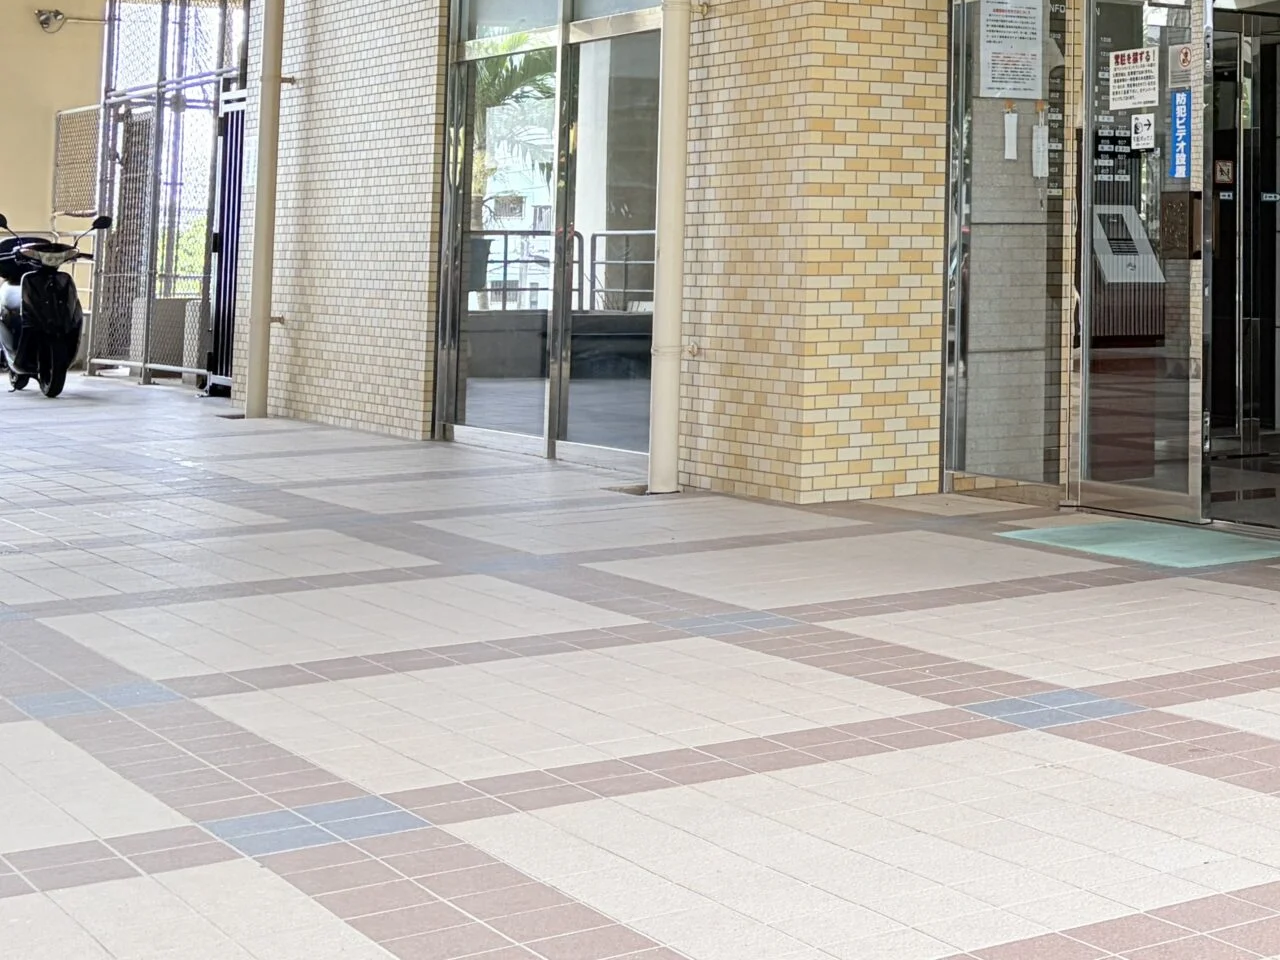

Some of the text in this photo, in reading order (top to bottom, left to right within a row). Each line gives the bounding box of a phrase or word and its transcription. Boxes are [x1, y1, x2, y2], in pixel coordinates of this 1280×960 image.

[1174, 92, 1188, 178] 防犯ビデオ設置
